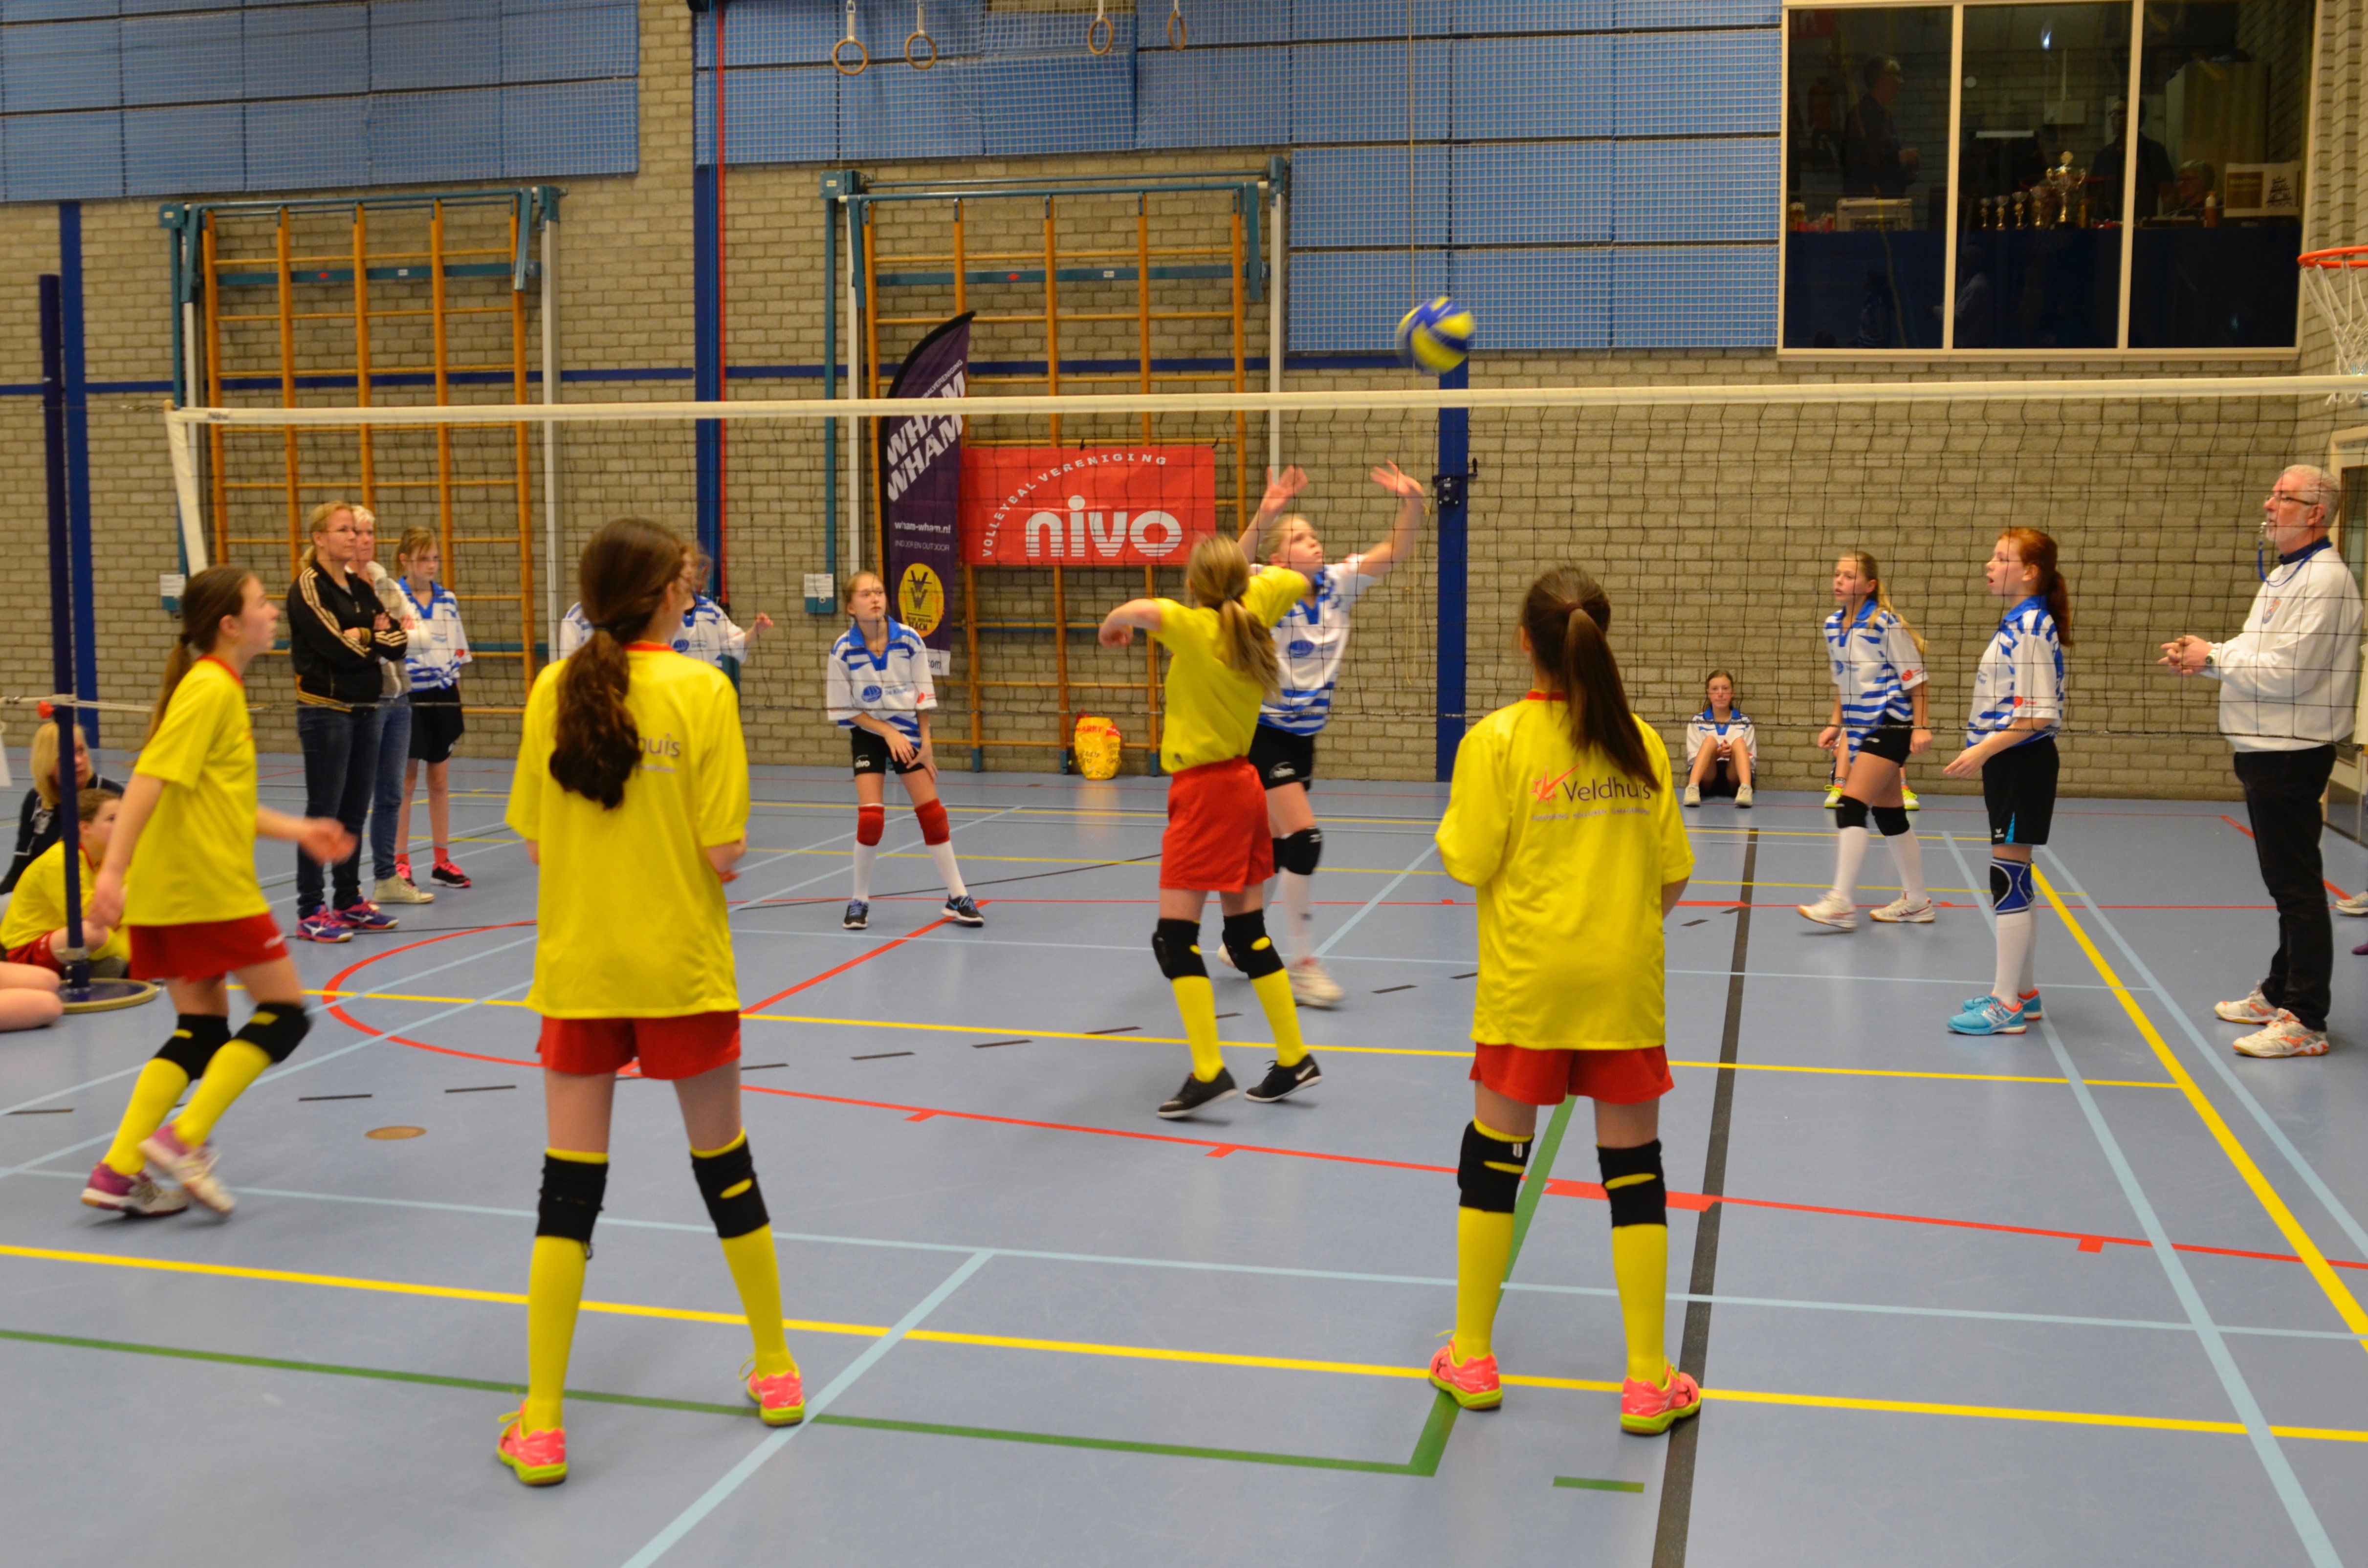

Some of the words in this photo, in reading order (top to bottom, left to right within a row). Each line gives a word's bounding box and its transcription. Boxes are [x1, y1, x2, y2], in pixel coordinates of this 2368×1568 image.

[887, 370, 965, 466] WHAM
[888, 414, 963, 502] WHAM
[894, 521, 951, 534] wham-wham.nl
[982, 482, 1036, 557] VOLLEYBAL
[1037, 453, 1166, 482] VERENIGING
[1025, 495, 1183, 557] nivo
[922, 543, 950, 551] OUTDOOR
